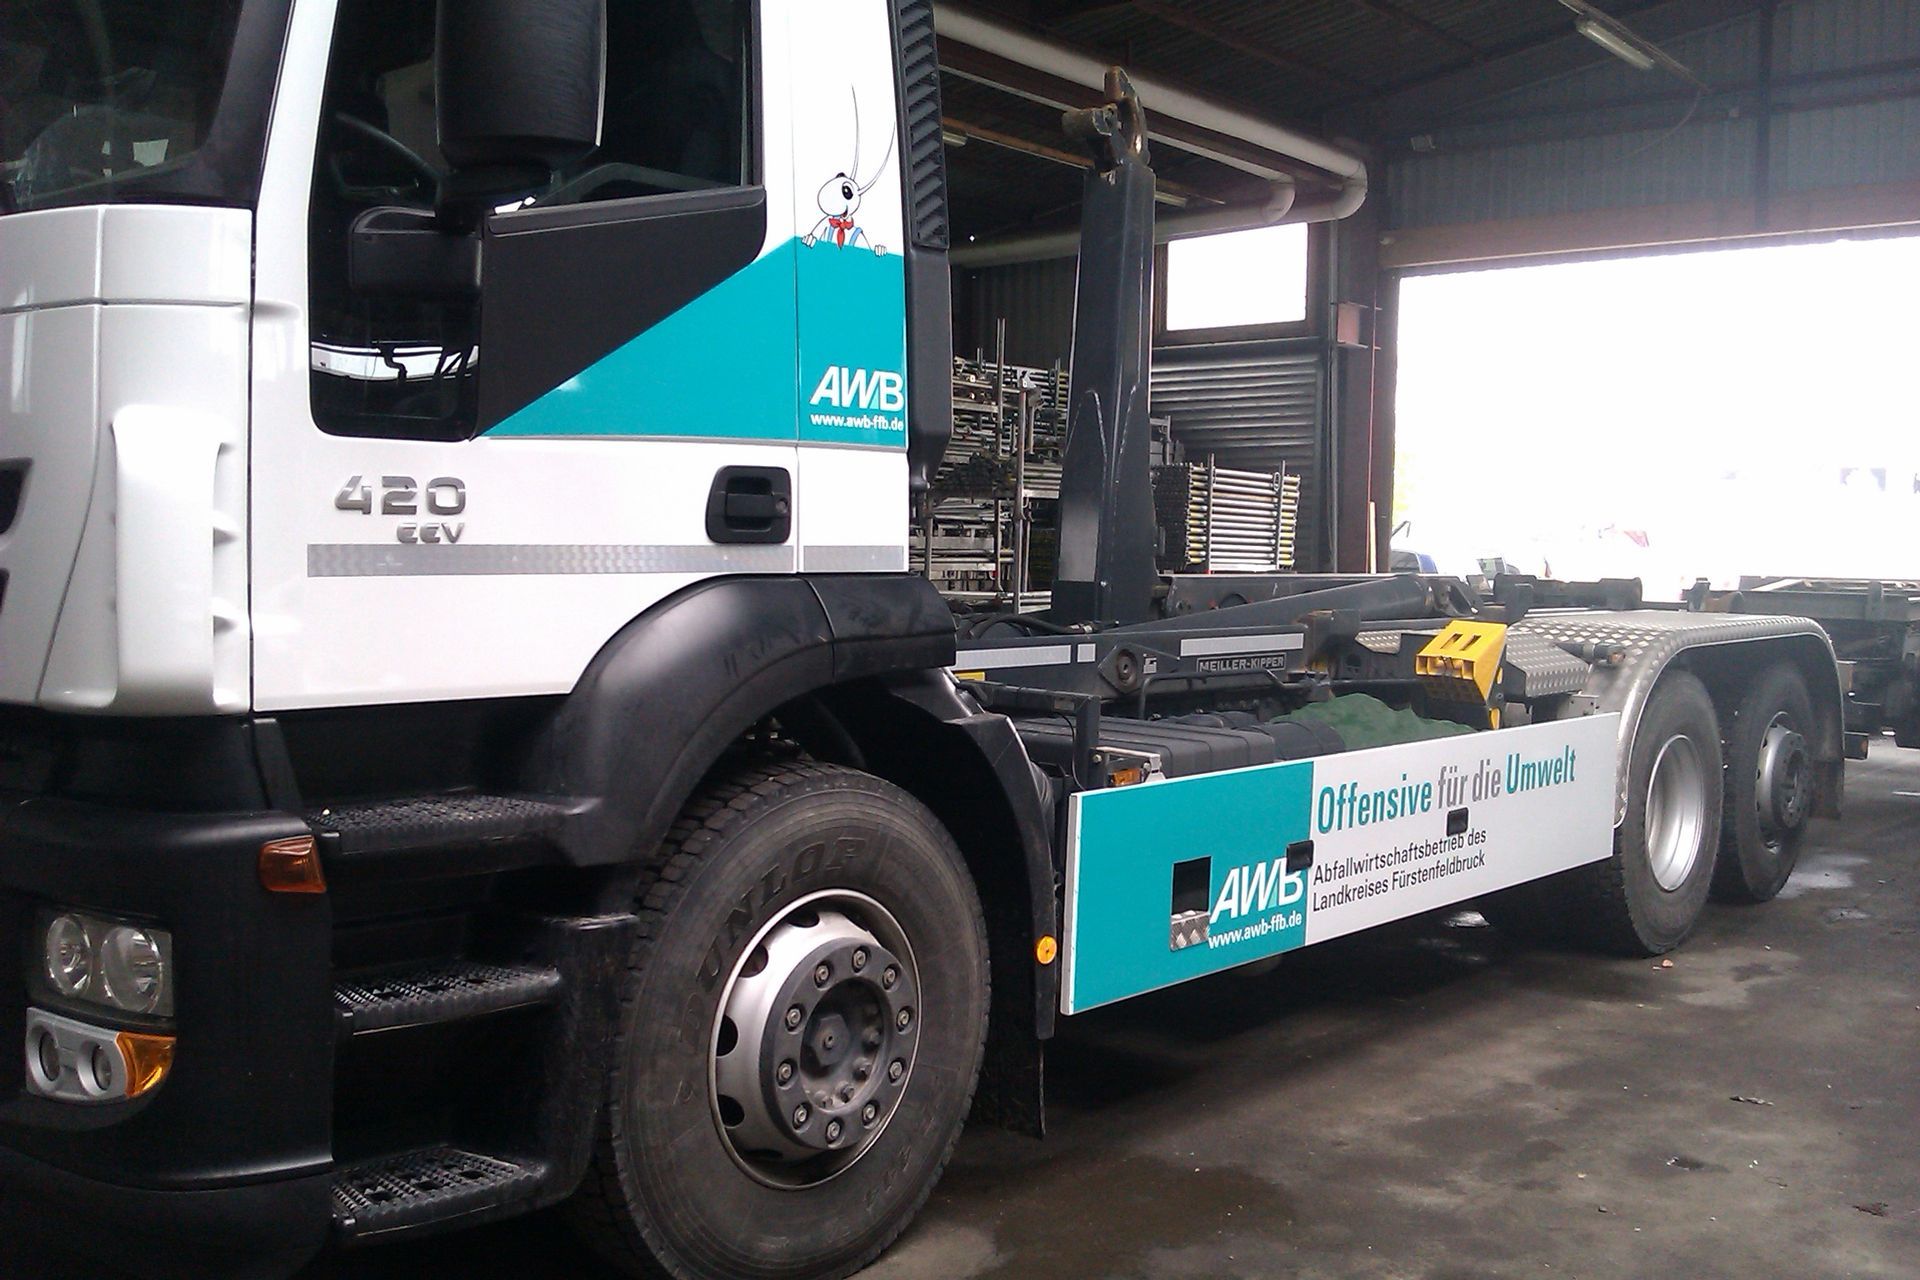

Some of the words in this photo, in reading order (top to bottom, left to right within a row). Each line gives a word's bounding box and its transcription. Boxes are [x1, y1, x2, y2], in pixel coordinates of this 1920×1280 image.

[809, 365, 904, 412] AWB
[810, 414, 904, 432] www.awb-ffb.de
[335, 475, 466, 516] 420
[396, 522, 466, 544] EEV
[1200, 656, 1284, 672] MEILLER-KIPPER
[1318, 773, 1432, 834] Offensive
[1437, 766, 1468, 809] für
[1472, 758, 1501, 801] die
[1505, 745, 1576, 794] Umwelt
[1313, 832, 1464, 886] Abfallwirtschaftsbetrieb
[1467, 828, 1487, 847] des
[1209, 857, 1304, 924] AWB
[1312, 878, 1389, 912] Landkreises
[1391, 850, 1485, 891] Fürstenfeldbruck
[1208, 910, 1303, 949] www.awb-ffb.de
